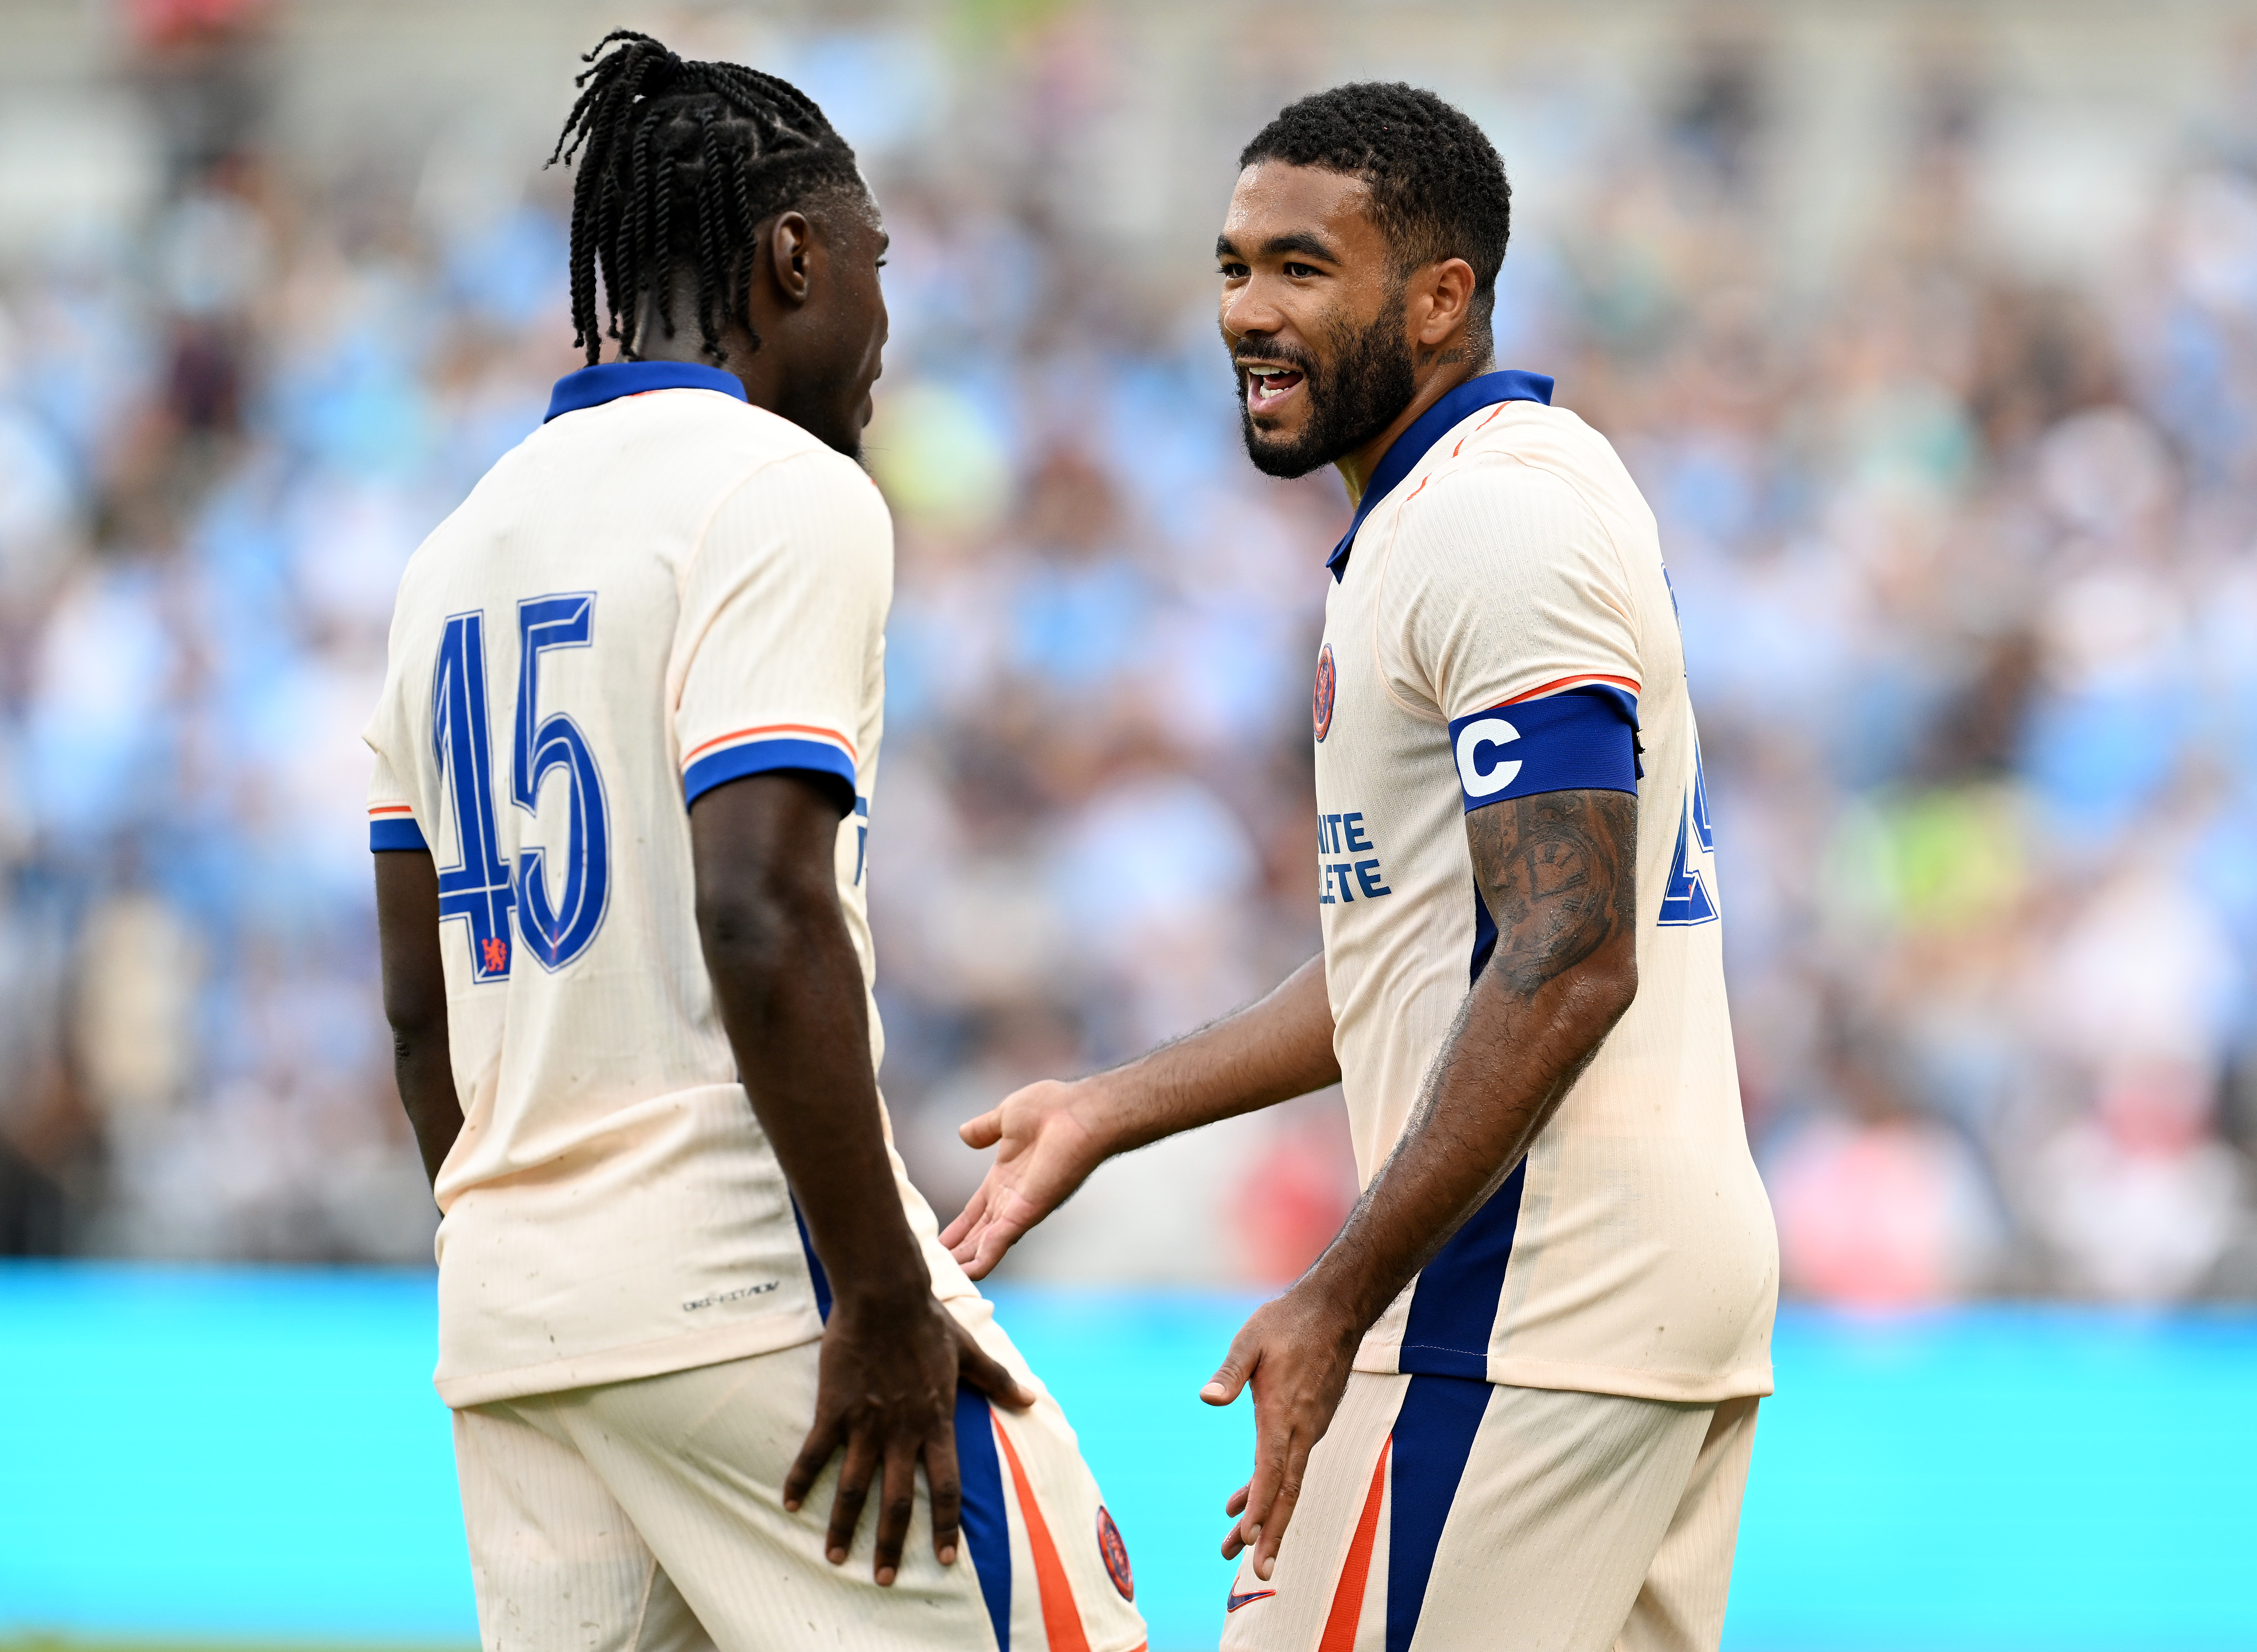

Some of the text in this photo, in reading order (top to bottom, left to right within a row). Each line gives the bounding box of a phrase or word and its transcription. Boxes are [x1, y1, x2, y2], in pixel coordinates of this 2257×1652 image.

[432, 591, 612, 984] 45
[1457, 718, 1523, 797] C
[1319, 859, 1392, 904] LETE
